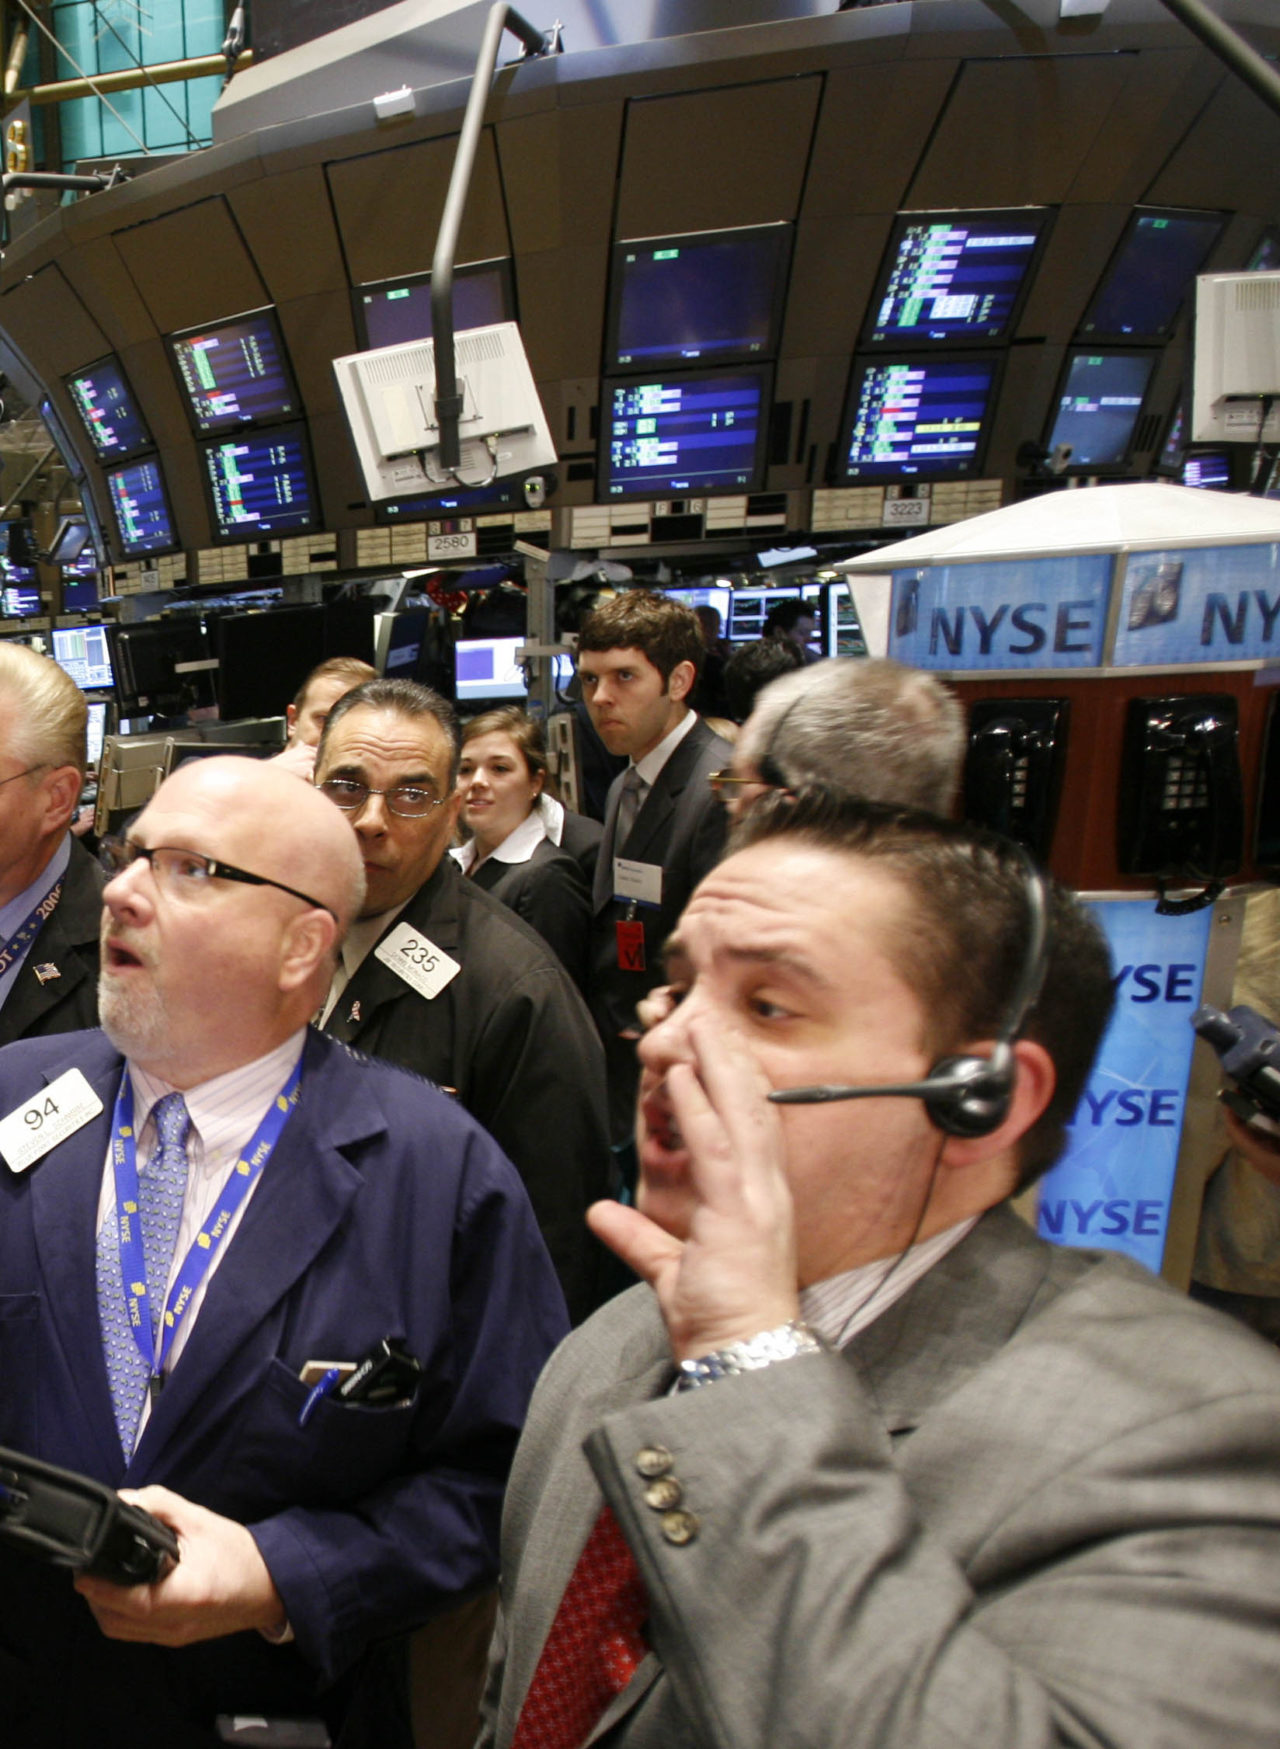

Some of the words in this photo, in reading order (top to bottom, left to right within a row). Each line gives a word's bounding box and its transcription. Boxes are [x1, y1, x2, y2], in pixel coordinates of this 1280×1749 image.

[890, 502, 923, 516] 3223
[434, 535, 470, 550] 2580
[928, 600, 1096, 656] NYSE
[400, 939, 440, 973] 235
[1114, 963, 1197, 1003] SE
[24, 1097, 60, 1131] 94
[1065, 1088, 1180, 1127] YSE
[113, 1138, 126, 1165] NYSE
[250, 1140, 272, 1167] NYSE
[120, 1215, 132, 1243] NYSE
[210, 1210, 232, 1239] NYSE
[1039, 1200, 1164, 1237] NYSE
[128, 1297, 142, 1328] NYSE
[173, 1285, 193, 1316] NYSE
